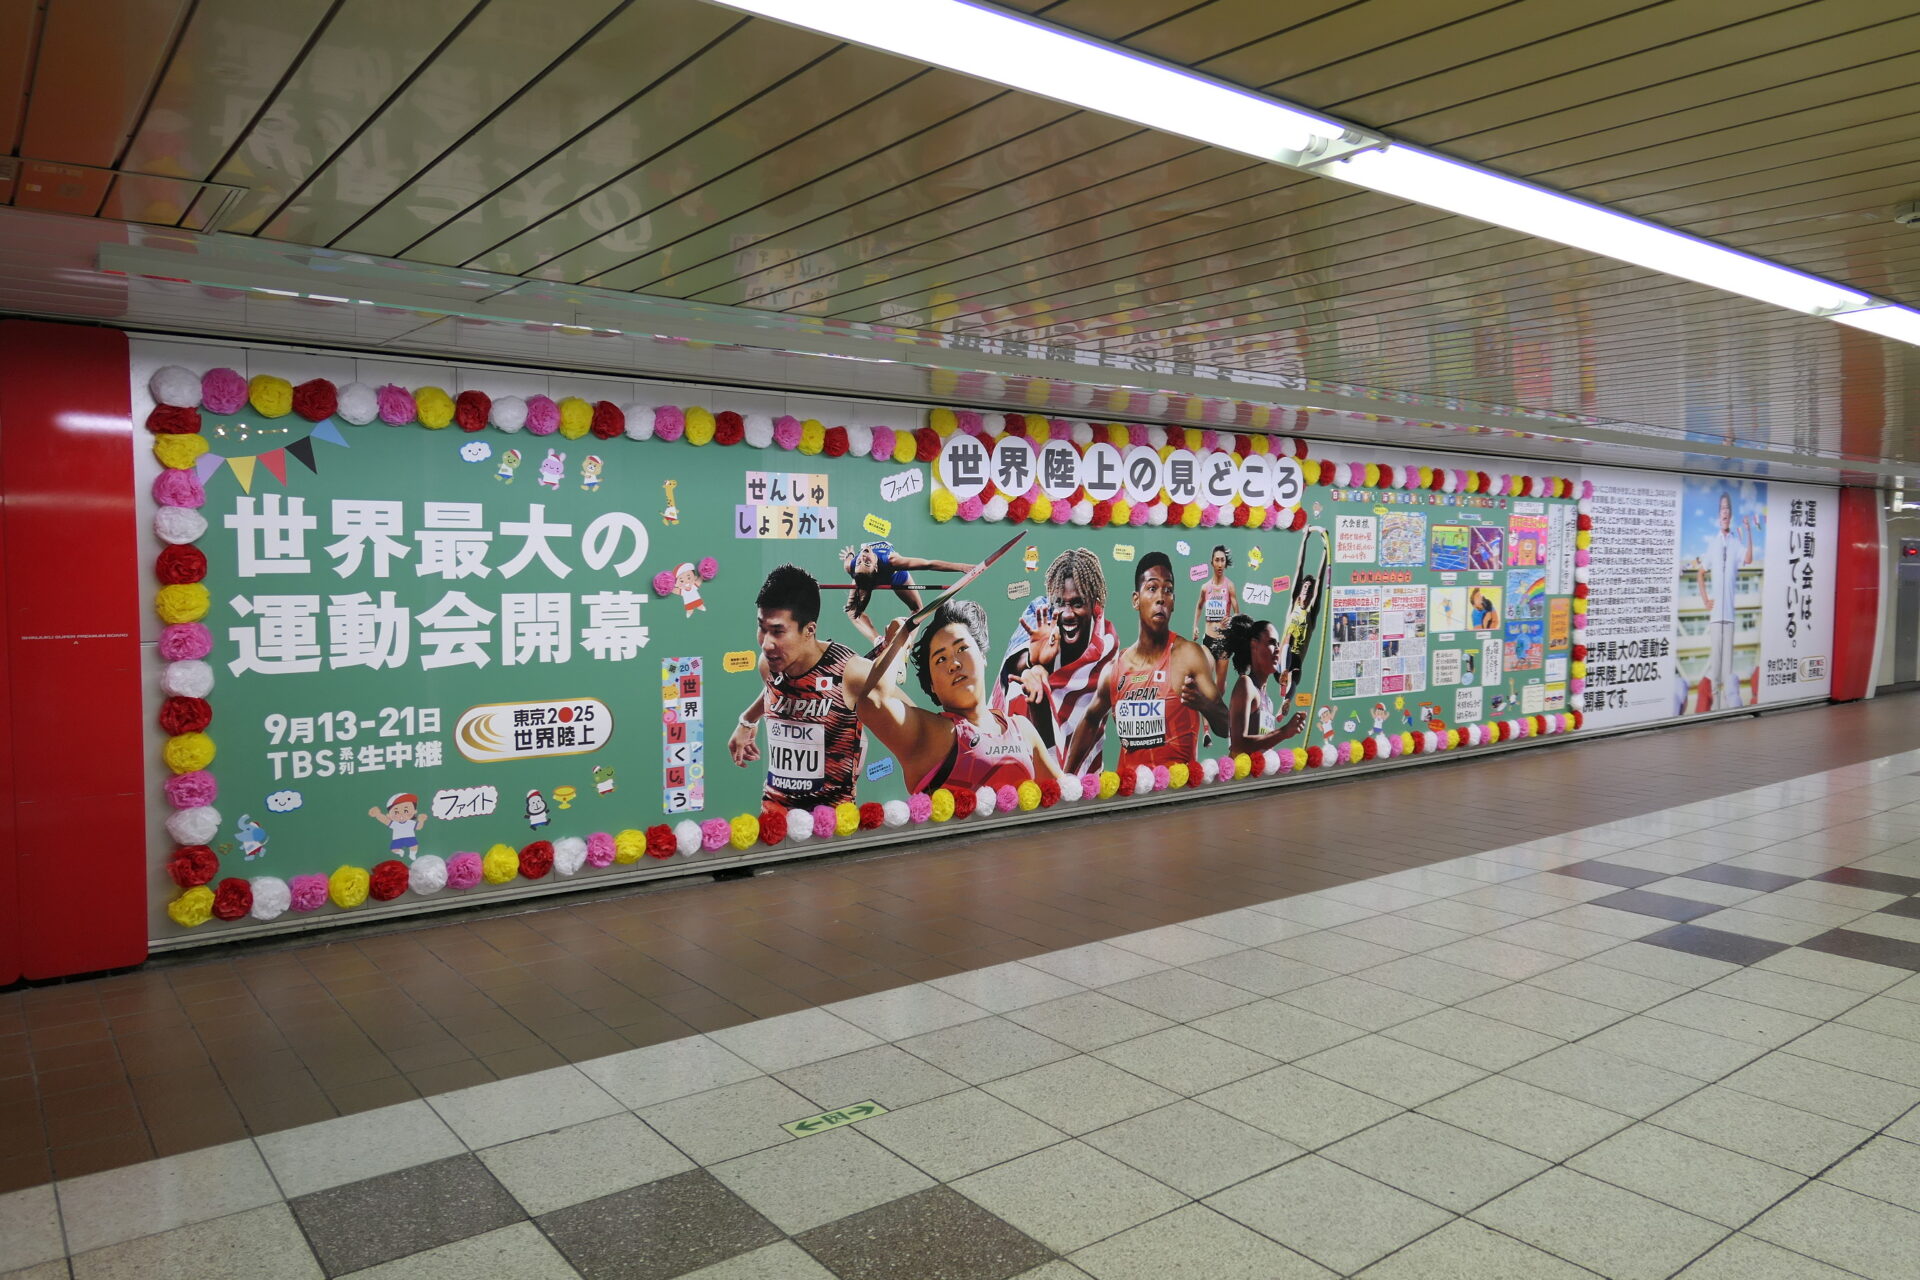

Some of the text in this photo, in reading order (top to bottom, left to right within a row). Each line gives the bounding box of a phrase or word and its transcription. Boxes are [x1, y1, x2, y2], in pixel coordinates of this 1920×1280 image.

[884, 471, 921, 497] ファイト
[948, 443, 1300, 500] 世界陸上の見どころ
[748, 476, 825, 506] せんしゅ
[739, 507, 836, 537] しょうかい
[223, 492, 650, 580] 世界最大の
[1786, 499, 1802, 648] 続いている。
[1801, 500, 1817, 630] 運動会は、
[1246, 587, 1270, 602] ファイト
[228, 590, 650, 677] 運動会開幕
[1586, 637, 1669, 664] 世界最大の運動会
[1585, 662, 1662, 688] 世界陸上2025、
[771, 695, 833, 717] JAPAN
[1129, 702, 1161, 716] TDK
[1583, 689, 1628, 713] 開幕です。
[265, 706, 441, 745] 9月13-21日
[513, 726, 595, 750] 世界陸上
[781, 724, 813, 740] TDK
[1118, 719, 1163, 736] SANI BROWN
[770, 744, 819, 772] KIRYU
[985, 745, 1022, 756] JAPAN
[440, 790, 494, 816] ファイト
